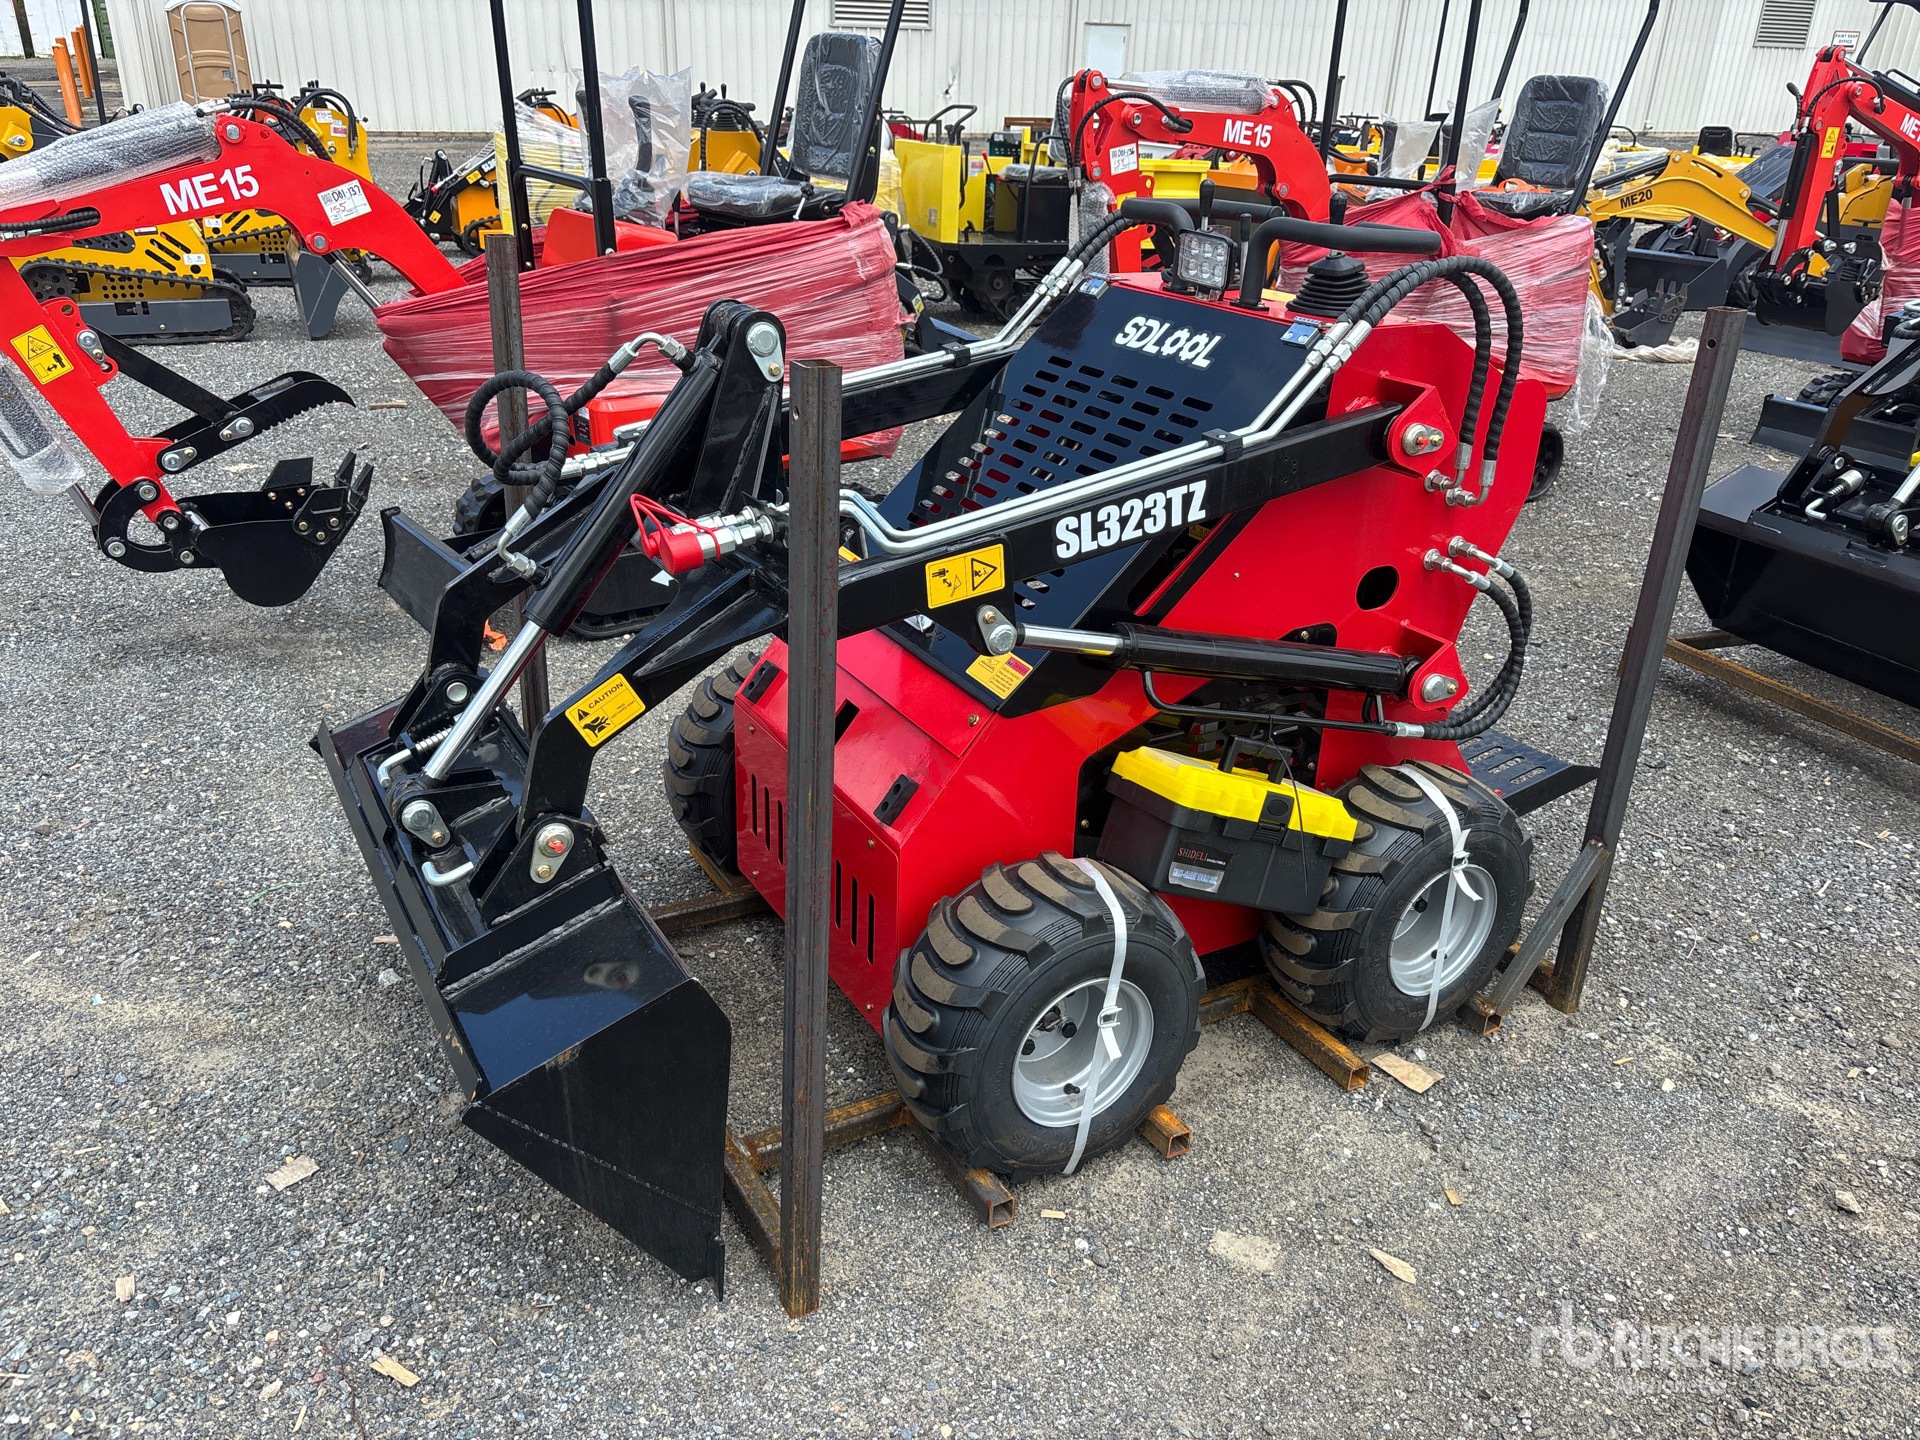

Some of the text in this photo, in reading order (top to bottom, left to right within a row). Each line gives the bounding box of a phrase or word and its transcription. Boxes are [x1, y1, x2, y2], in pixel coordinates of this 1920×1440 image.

[1222, 118, 1273, 148] ME15
[160, 164, 260, 216] ME15
[1619, 188, 1654, 210] ME20
[1114, 315, 1222, 369] SDLOOL
[1055, 479, 1207, 559] SL323TZ
[588, 681, 624, 709] CAUTION
[1177, 847, 1208, 861] SHIDELI
